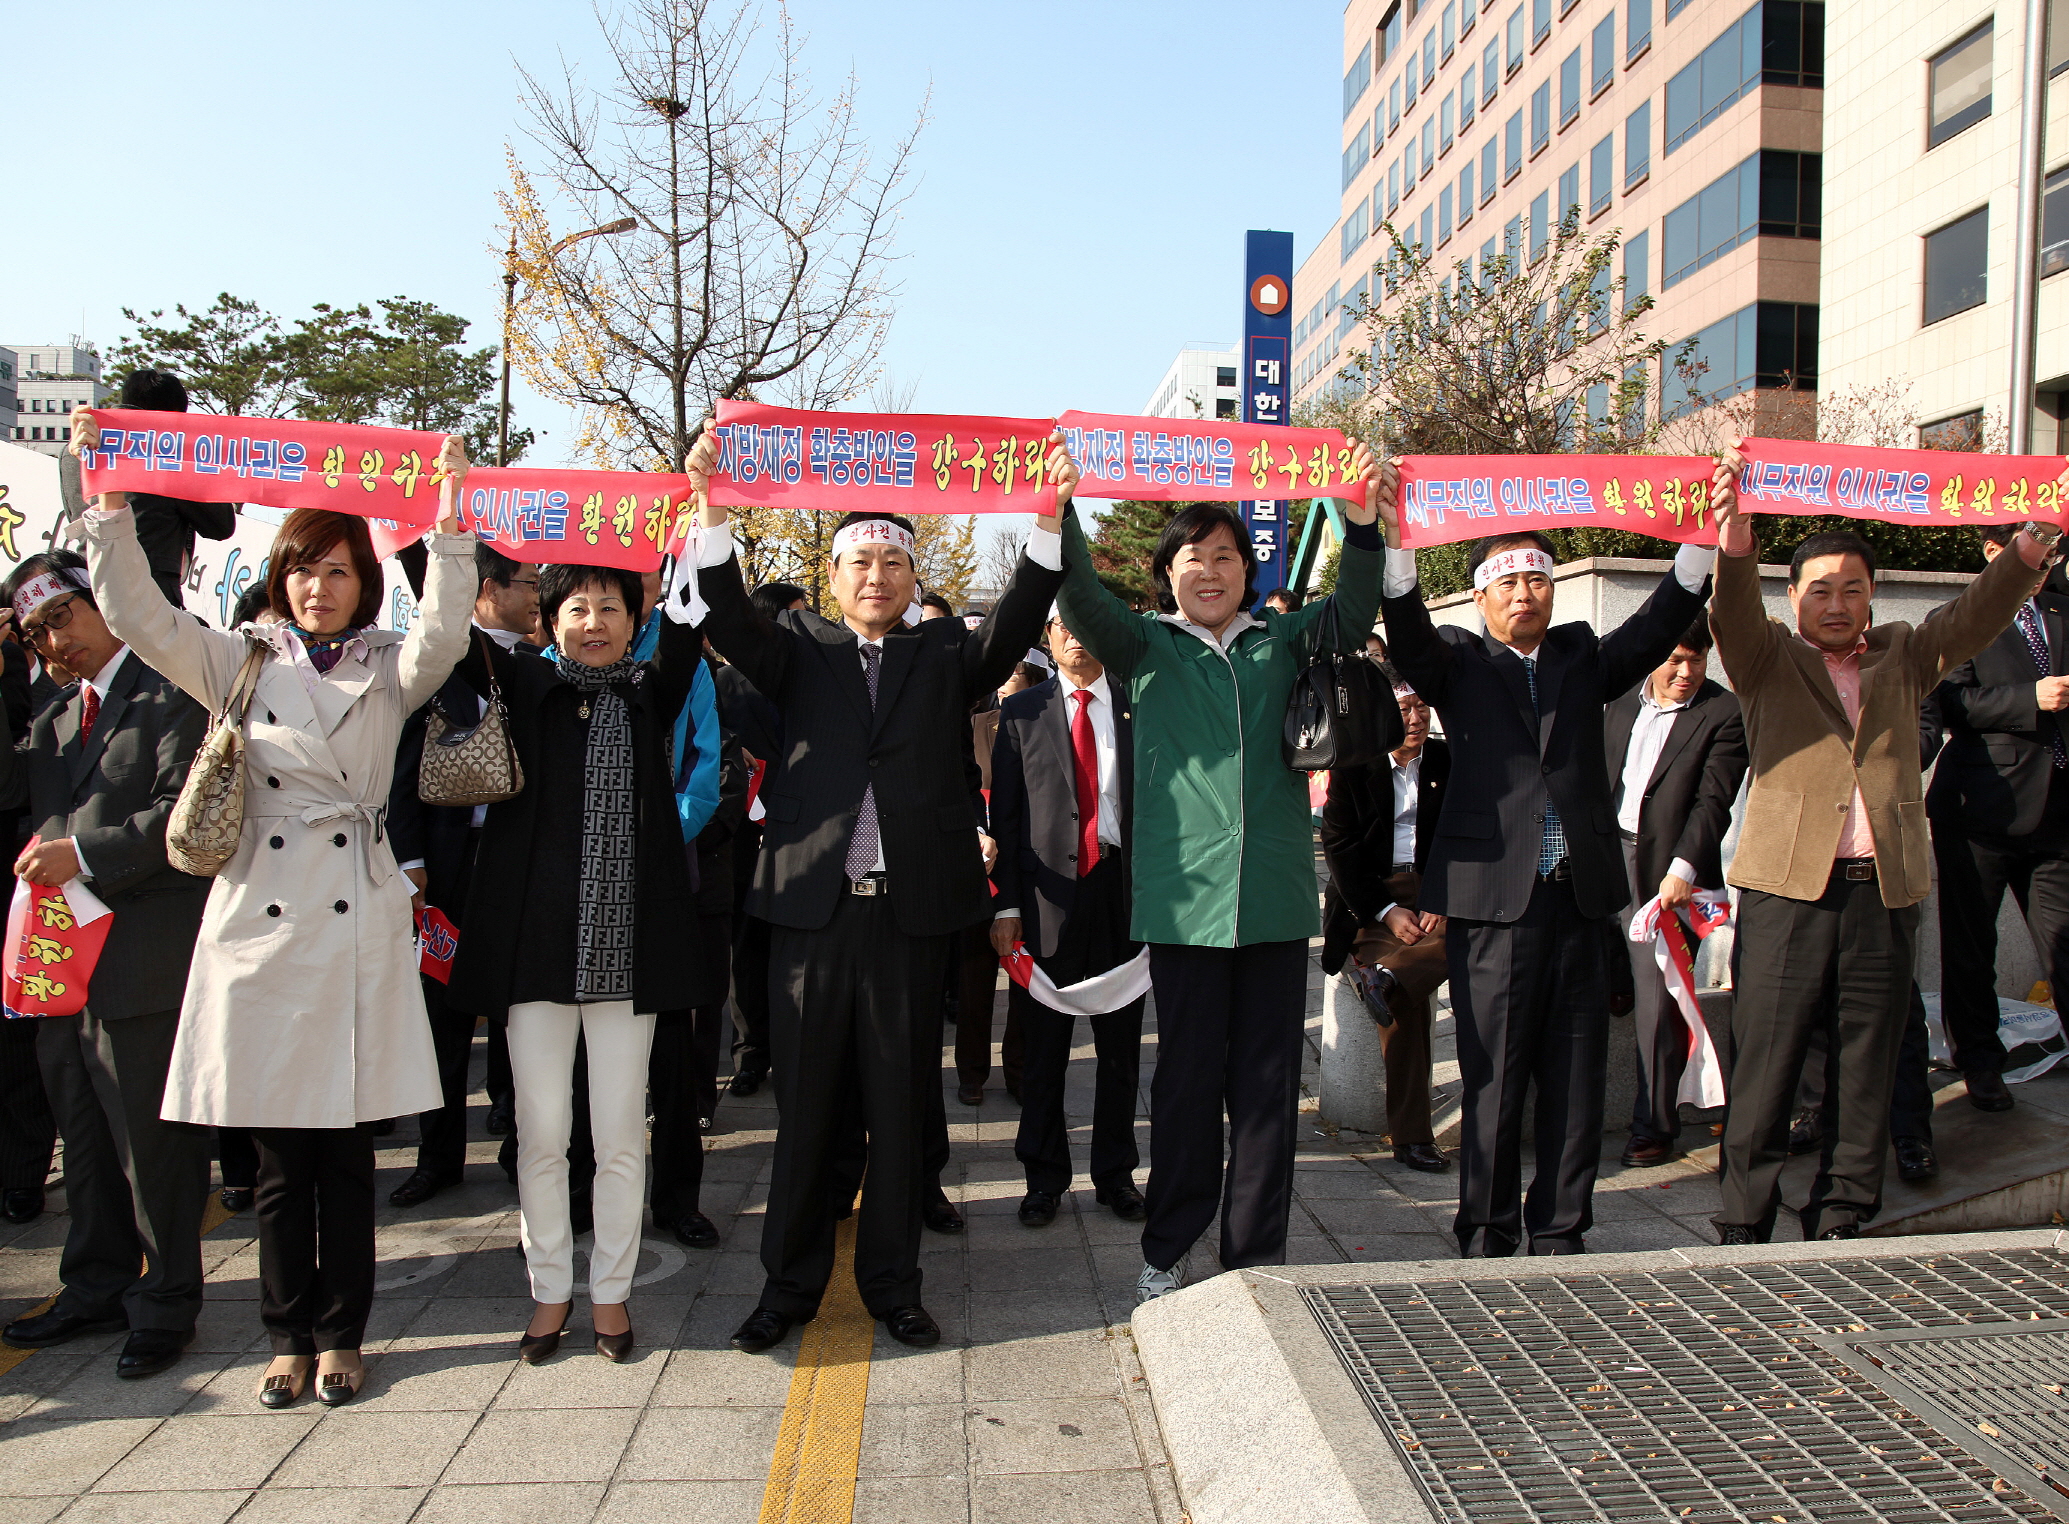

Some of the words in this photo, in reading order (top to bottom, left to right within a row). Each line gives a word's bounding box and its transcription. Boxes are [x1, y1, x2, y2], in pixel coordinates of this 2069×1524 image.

[715, 423, 803, 484] 지방재정
[809, 427, 918, 487] 확충방안을
[931, 432, 1051, 495] 강구하라
[1053, 425, 1125, 481] 방재정
[1131, 430, 1236, 488] 확충방안을
[471, 487, 569, 542] 인사권을
[1405, 477, 1498, 528] 사무직원
[1500, 476, 1597, 516] 인사권을
[1602, 477, 1710, 530] 환원하라
[1836, 467, 1932, 515] 인사권을
[1940, 473, 2065, 518] 환원하라
